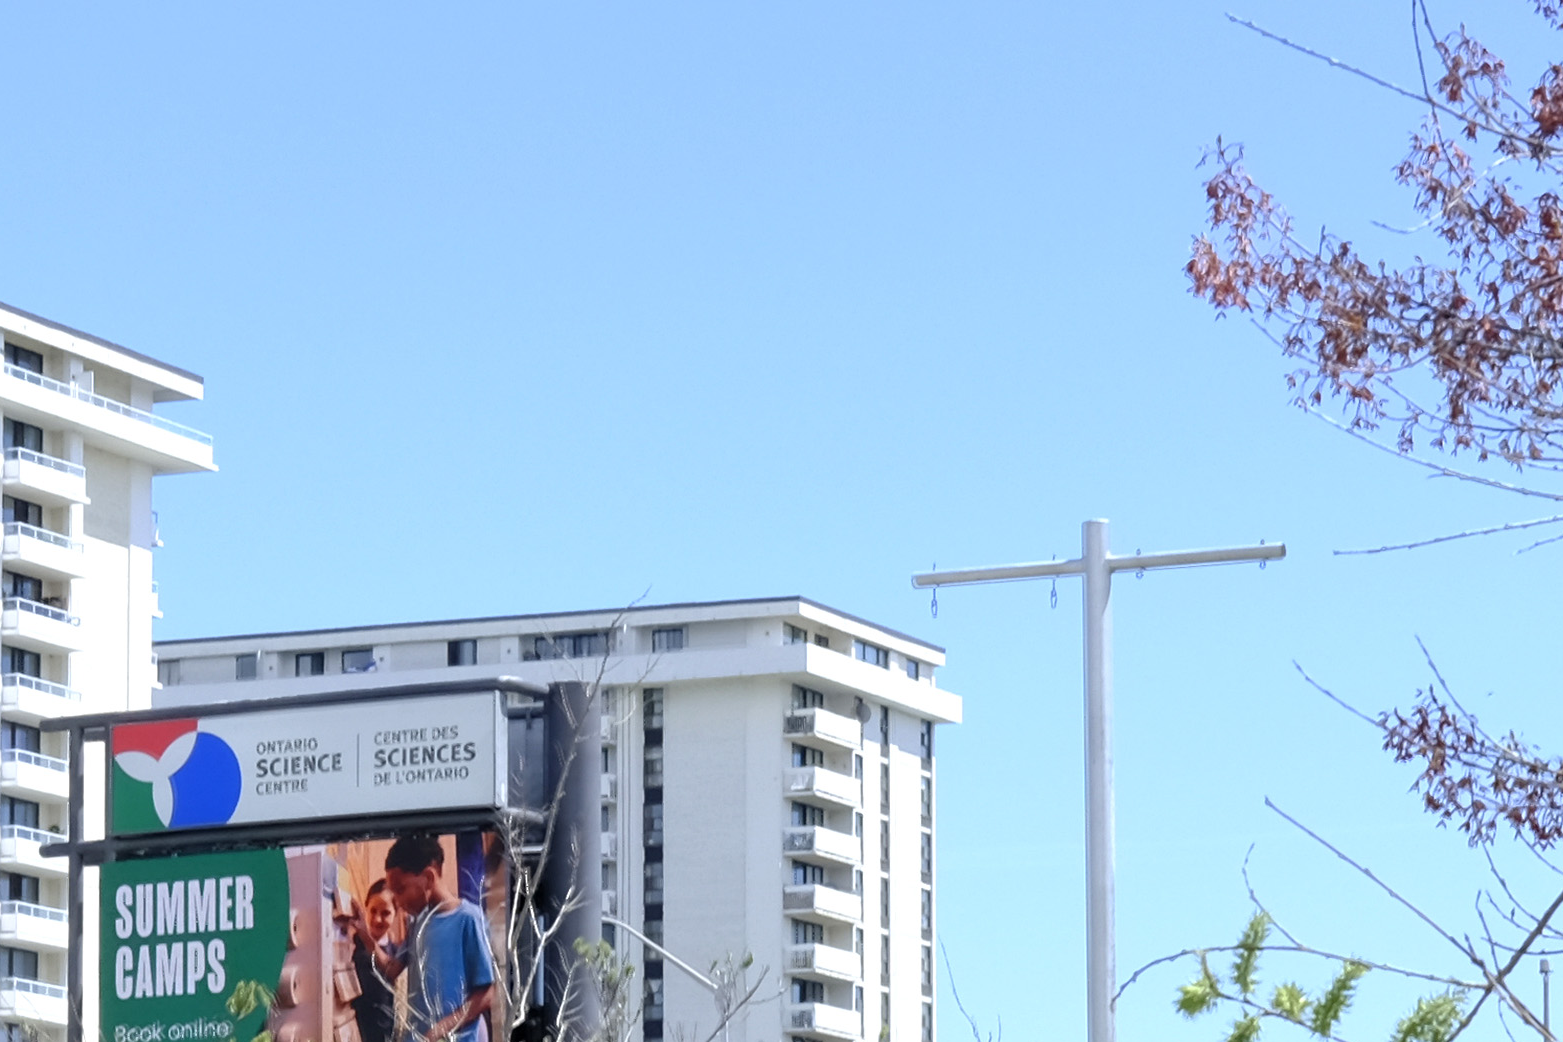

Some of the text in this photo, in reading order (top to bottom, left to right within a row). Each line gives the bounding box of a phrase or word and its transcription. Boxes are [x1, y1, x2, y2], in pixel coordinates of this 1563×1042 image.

[256, 737, 318, 756] ONTARIO
[374, 725, 459, 746] CENTRE DES
[256, 752, 343, 778] SCIENCE
[374, 742, 477, 769] SCIENCES
[256, 778, 308, 796] CENTRE
[374, 766, 469, 787] DE L'ONTARIO
[115, 875, 254, 939] SUMMER
[115, 938, 226, 1000] CAMPS
[167, 1017, 233, 1041] online
